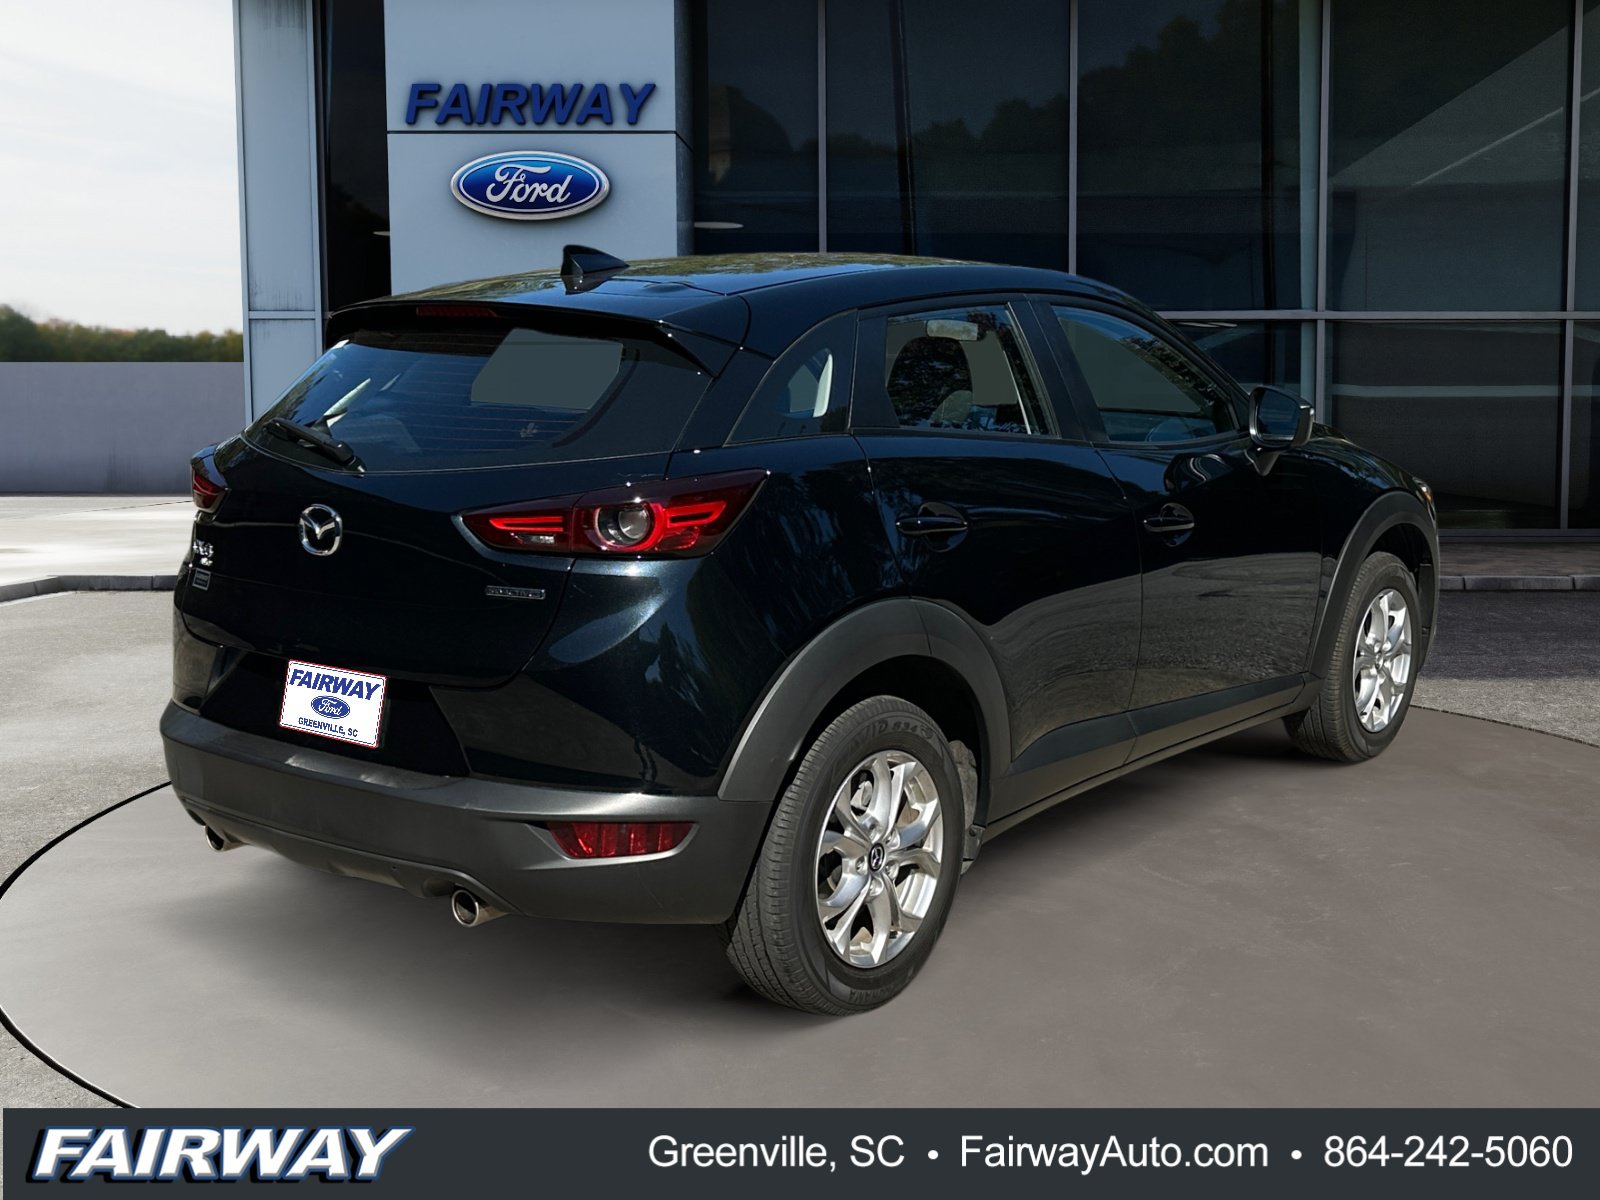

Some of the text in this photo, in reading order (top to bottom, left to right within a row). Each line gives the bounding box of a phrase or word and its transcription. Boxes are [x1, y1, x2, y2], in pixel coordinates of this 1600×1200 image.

[405, 83, 656, 126] FAIRWAY
[485, 164, 574, 203] Ford
[289, 669, 381, 701] FAIRWAY
[318, 699, 342, 716] Ford
[298, 717, 358, 737] GREENVILLE, SC
